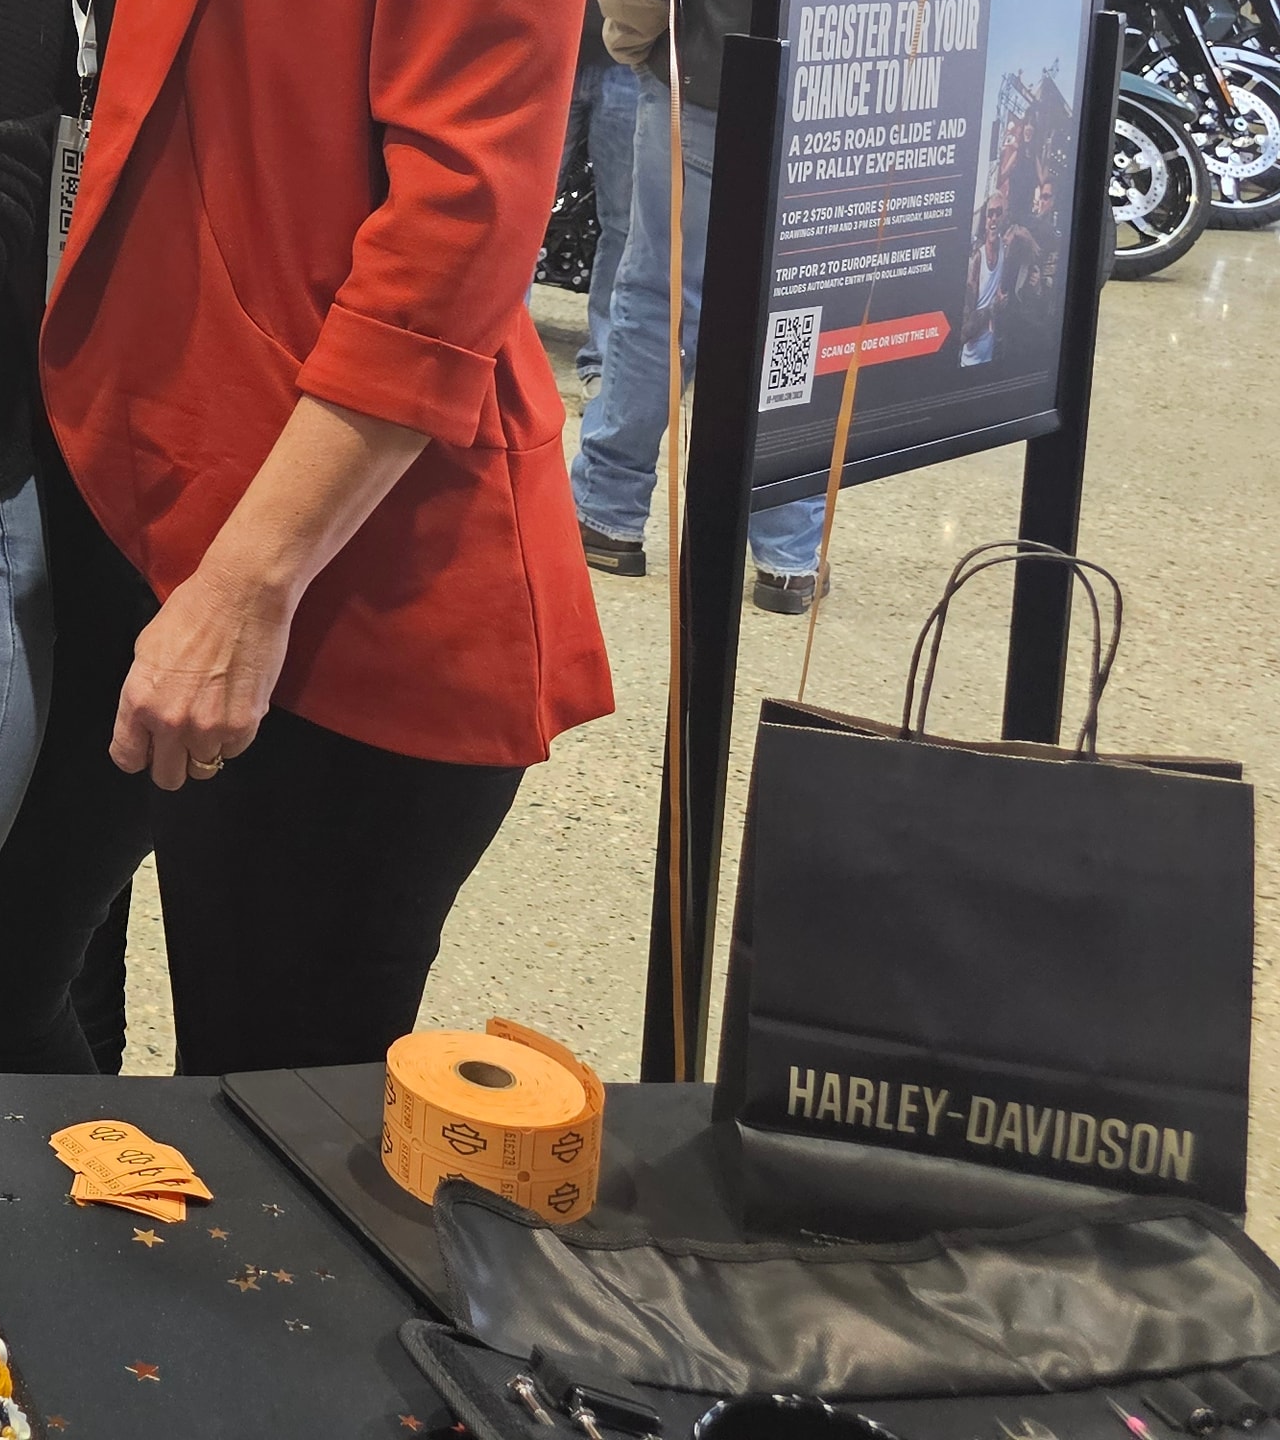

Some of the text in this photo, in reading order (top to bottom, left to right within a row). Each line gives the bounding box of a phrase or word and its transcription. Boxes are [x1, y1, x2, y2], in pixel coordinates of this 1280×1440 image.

[797, 2, 892, 62] REGISTER
[894, 0, 930, 56] FOR
[792, 61, 873, 123] CHANCE
[875, 59, 900, 114] TO
[788, 134, 801, 157] A
[803, 130, 842, 156] 2025
[844, 126, 886, 151] ROAD
[937, 117, 967, 141] AND
[787, 144, 956, 184] VIP RALLY EXPERIENCE
[780, 227, 815, 241] DRAWINGS
[815, 225, 824, 235] AT
[828, 223, 839, 233] PM
[839, 221, 853, 232] AND
[858, 219, 868, 229] PM
[891, 211, 923, 225] SATURDAY,
[923, 208, 944, 221] MARCH
[782, 212, 787, 226] 1
[788, 211, 802, 225] OF
[803, 210, 809, 223] 2
[810, 208, 834, 223] $750
[834, 200, 878, 219] IN-STORE
[923, 190, 956, 206] SPREES
[773, 283, 807, 297] INCLUDES
[807, 277, 844, 292] AUTOMATIC
[845, 274, 865, 286] ENTRY
[881, 266, 907, 280] ROLLING
[907, 262, 933, 275] AUSTRIA
[776, 245, 936, 282] TRIP FOR 2 TO EUROPEAN BIKE WEEK
[821, 327, 939, 359] SCAN QR ODE OR VISIT THE URL
[787, 1065, 1196, 1183] HARLEY-DAVIDSON
[504, 1131, 517, 1168] 616279
